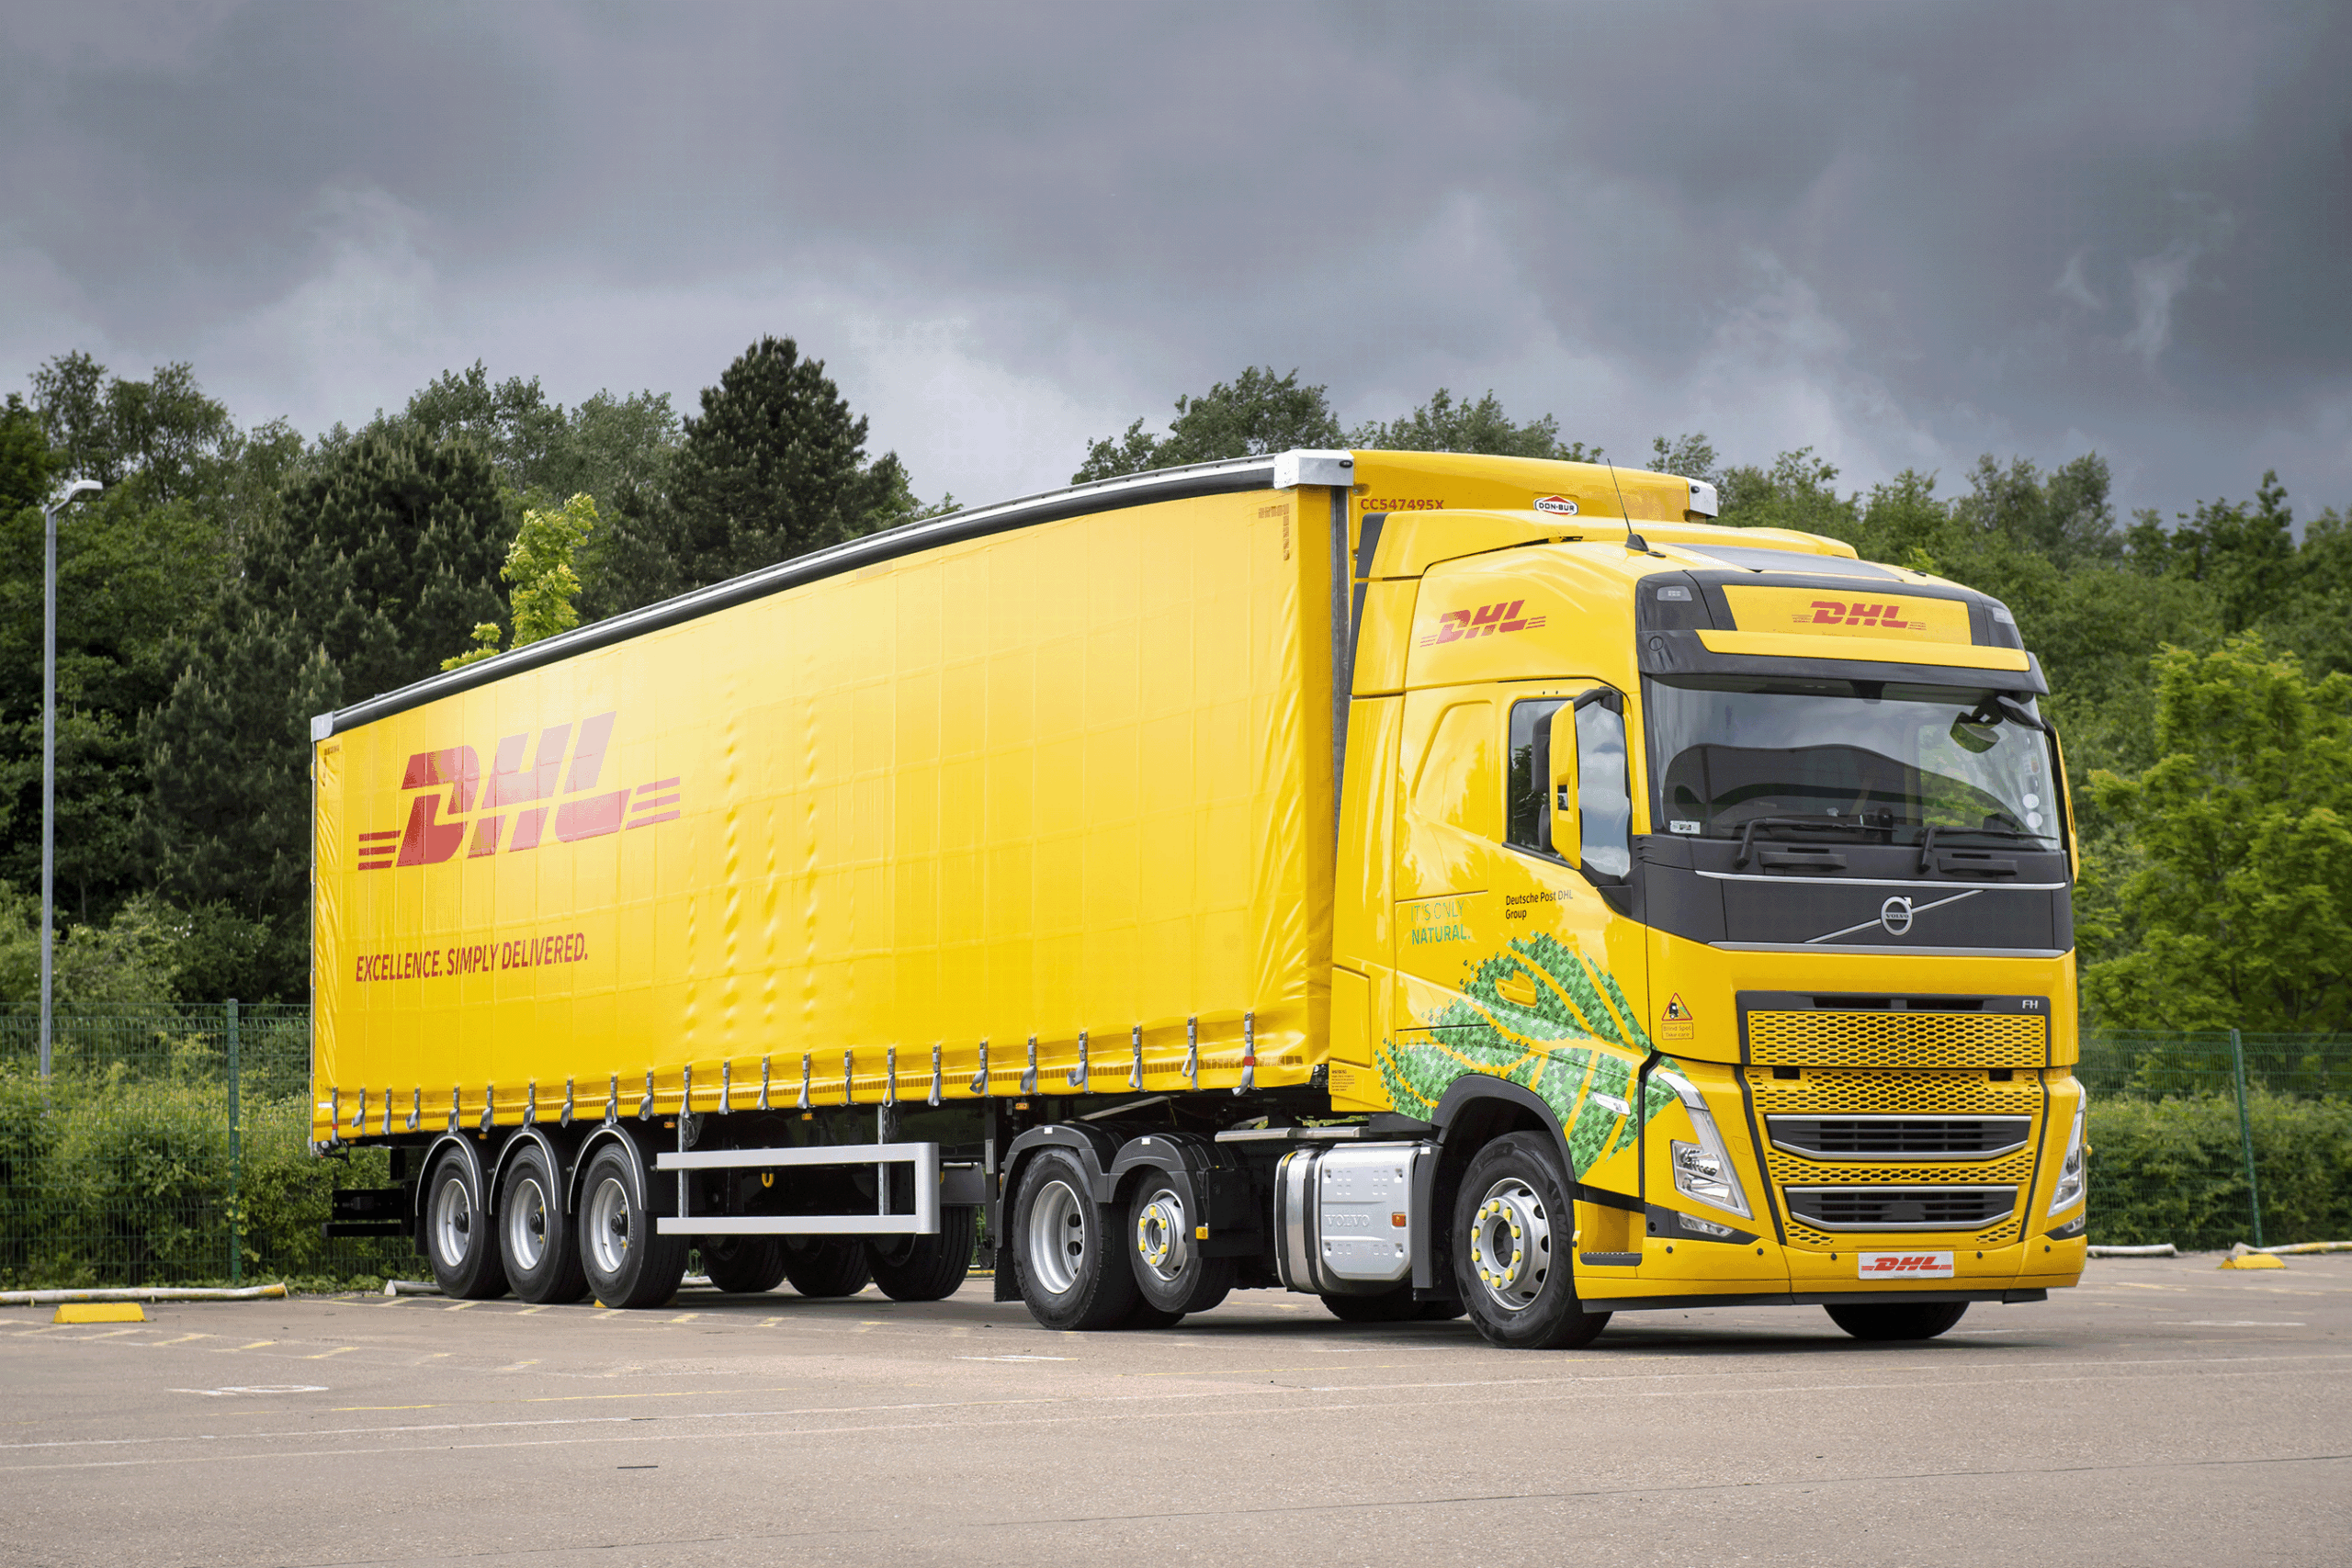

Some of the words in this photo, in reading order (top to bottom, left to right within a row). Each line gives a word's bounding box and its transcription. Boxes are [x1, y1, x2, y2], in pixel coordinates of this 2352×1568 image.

[1361, 498, 1444, 511] CC547495X
[1539, 502, 1575, 512] DON-BUR
[1435, 599, 1528, 645] DHL
[1810, 600, 1909, 629] DHL
[396, 710, 632, 868] DHL
[1506, 892, 1539, 906] Deutsche
[1540, 891, 1556, 902] Post
[1557, 889, 1574, 900] DHL
[1410, 903, 1431, 922] IT'S
[1433, 899, 1465, 919] ONLY
[1505, 908, 1527, 920] Group
[1411, 923, 1471, 945] NATURAL.
[356, 949, 443, 982] EXCELLENCE.
[447, 942, 499, 976] SIMPLY
[502, 931, 588, 970] DELIVERED.
[2022, 999, 2039, 1010] FH
[1323, 1213, 1371, 1227] VOLVO
[1874, 1256, 1940, 1271] DHL
